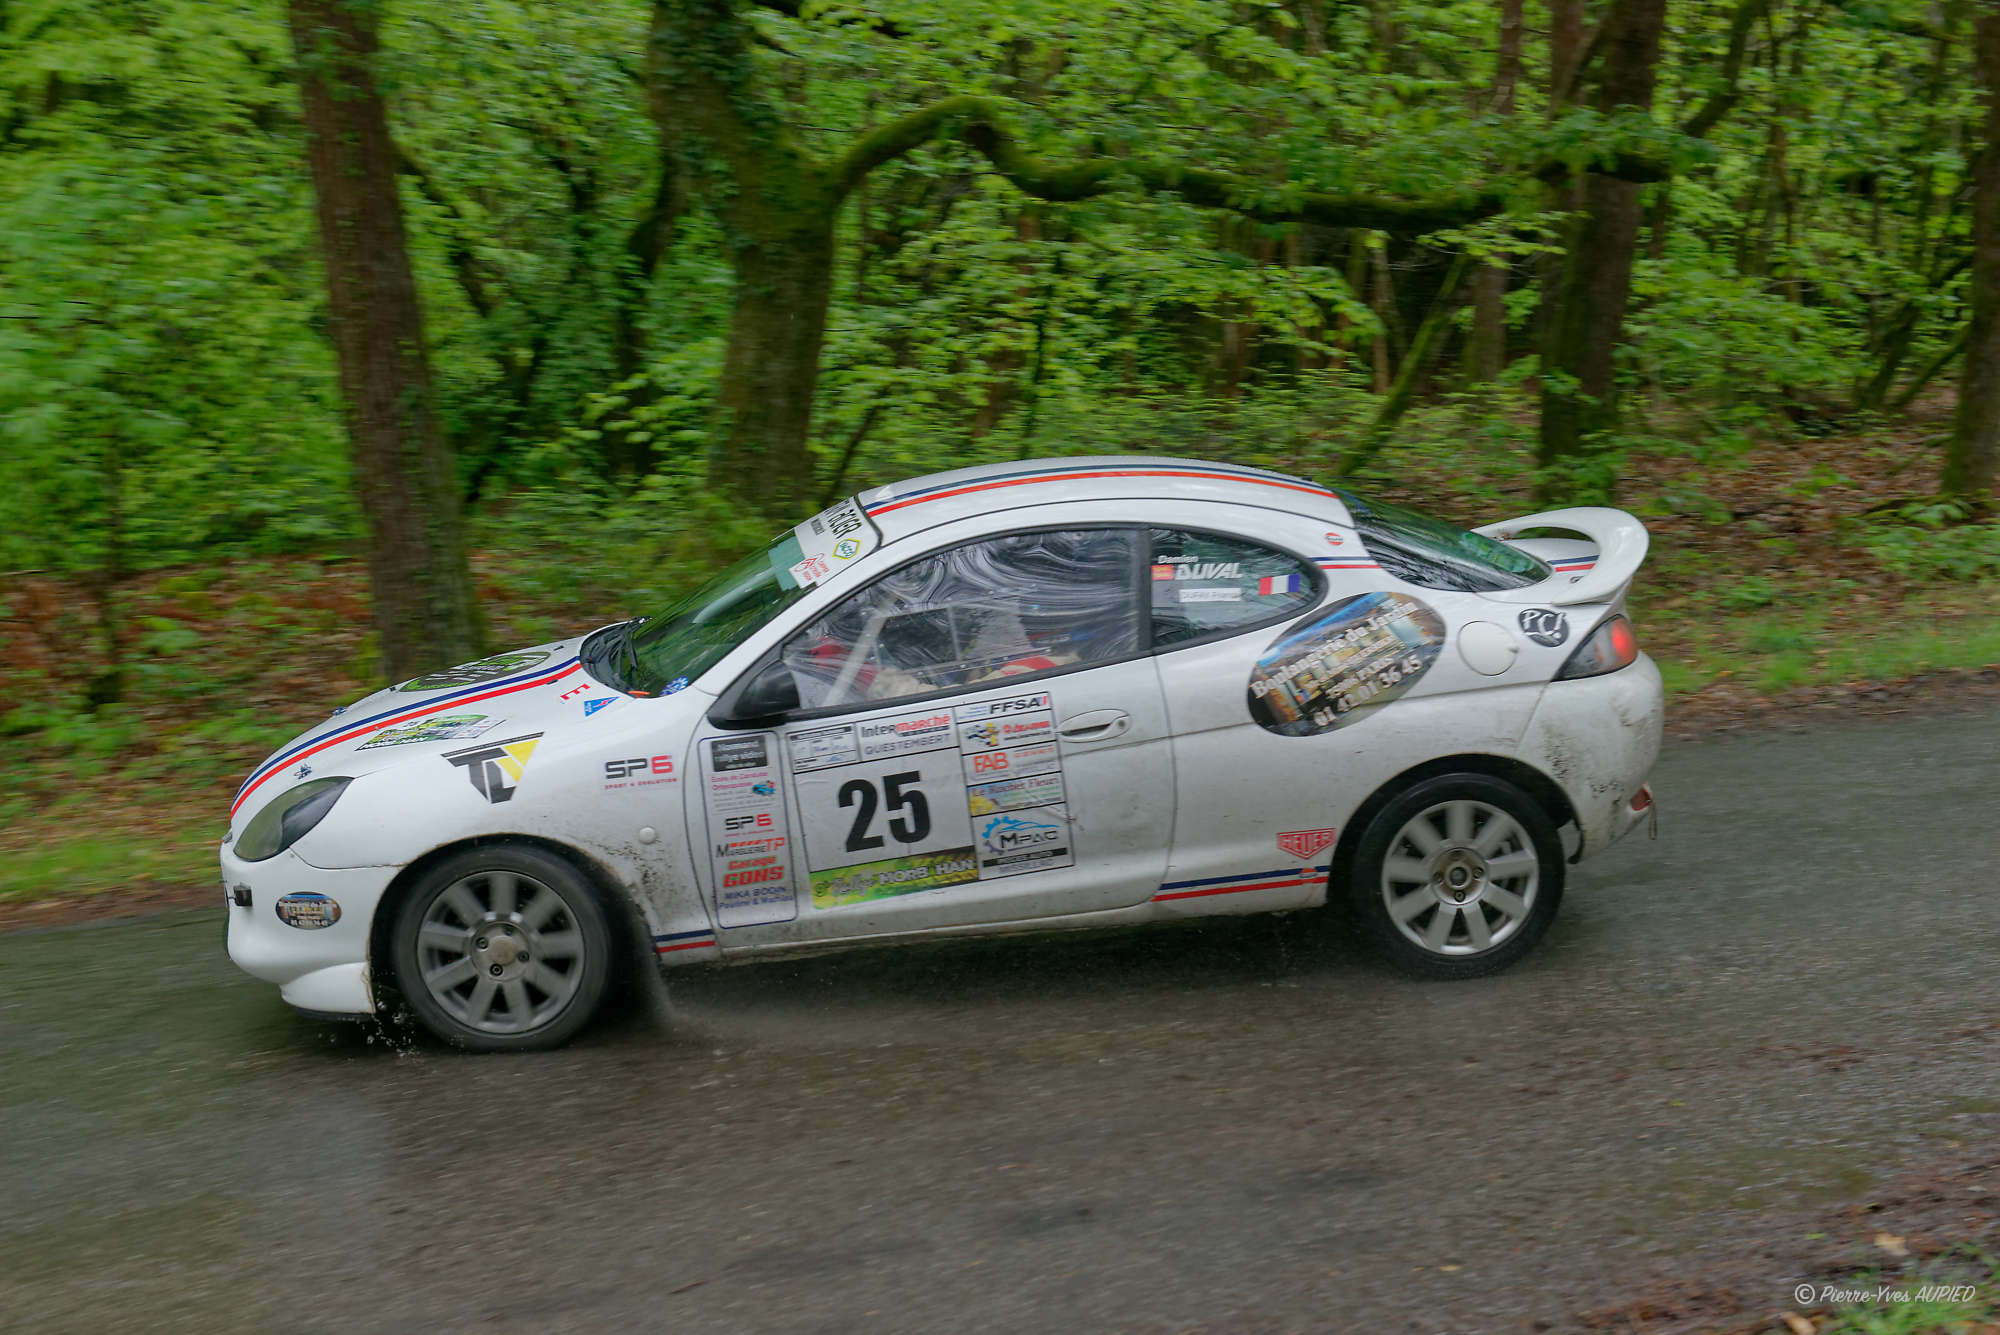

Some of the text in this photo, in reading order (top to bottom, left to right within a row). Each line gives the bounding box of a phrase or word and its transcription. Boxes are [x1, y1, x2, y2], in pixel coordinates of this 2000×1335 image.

[1175, 563, 1245, 581] DUVAL
[1378, 665, 1403, 689] 36
[1401, 653, 1423, 675] 45
[989, 697, 1041, 715] FFSA
[861, 713, 951, 739] Intermarché
[864, 733, 951, 756] QUESTEMBERT
[605, 755, 673, 780] SP6
[973, 751, 1010, 773] FAB
[725, 813, 773, 831] SP6
[838, 770, 931, 852] 25
[728, 856, 777, 871] Garage
[723, 866, 785, 889] GONS
